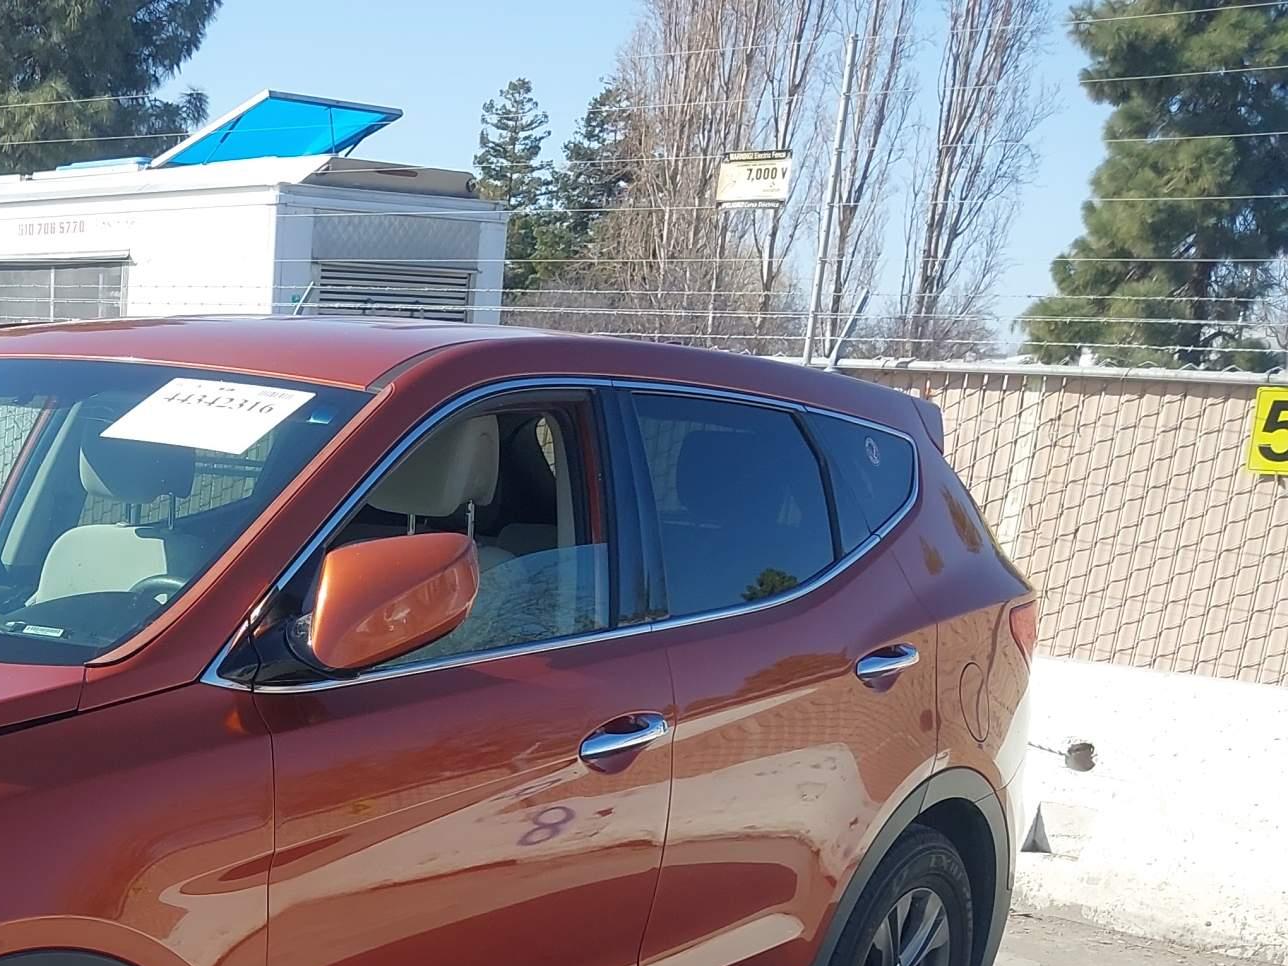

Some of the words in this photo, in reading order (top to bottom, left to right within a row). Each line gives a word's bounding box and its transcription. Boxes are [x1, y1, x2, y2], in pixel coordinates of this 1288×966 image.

[746, 167, 778, 182] 7,000
[781, 167, 788, 179] V
[163, 391, 276, 414] 44342316
